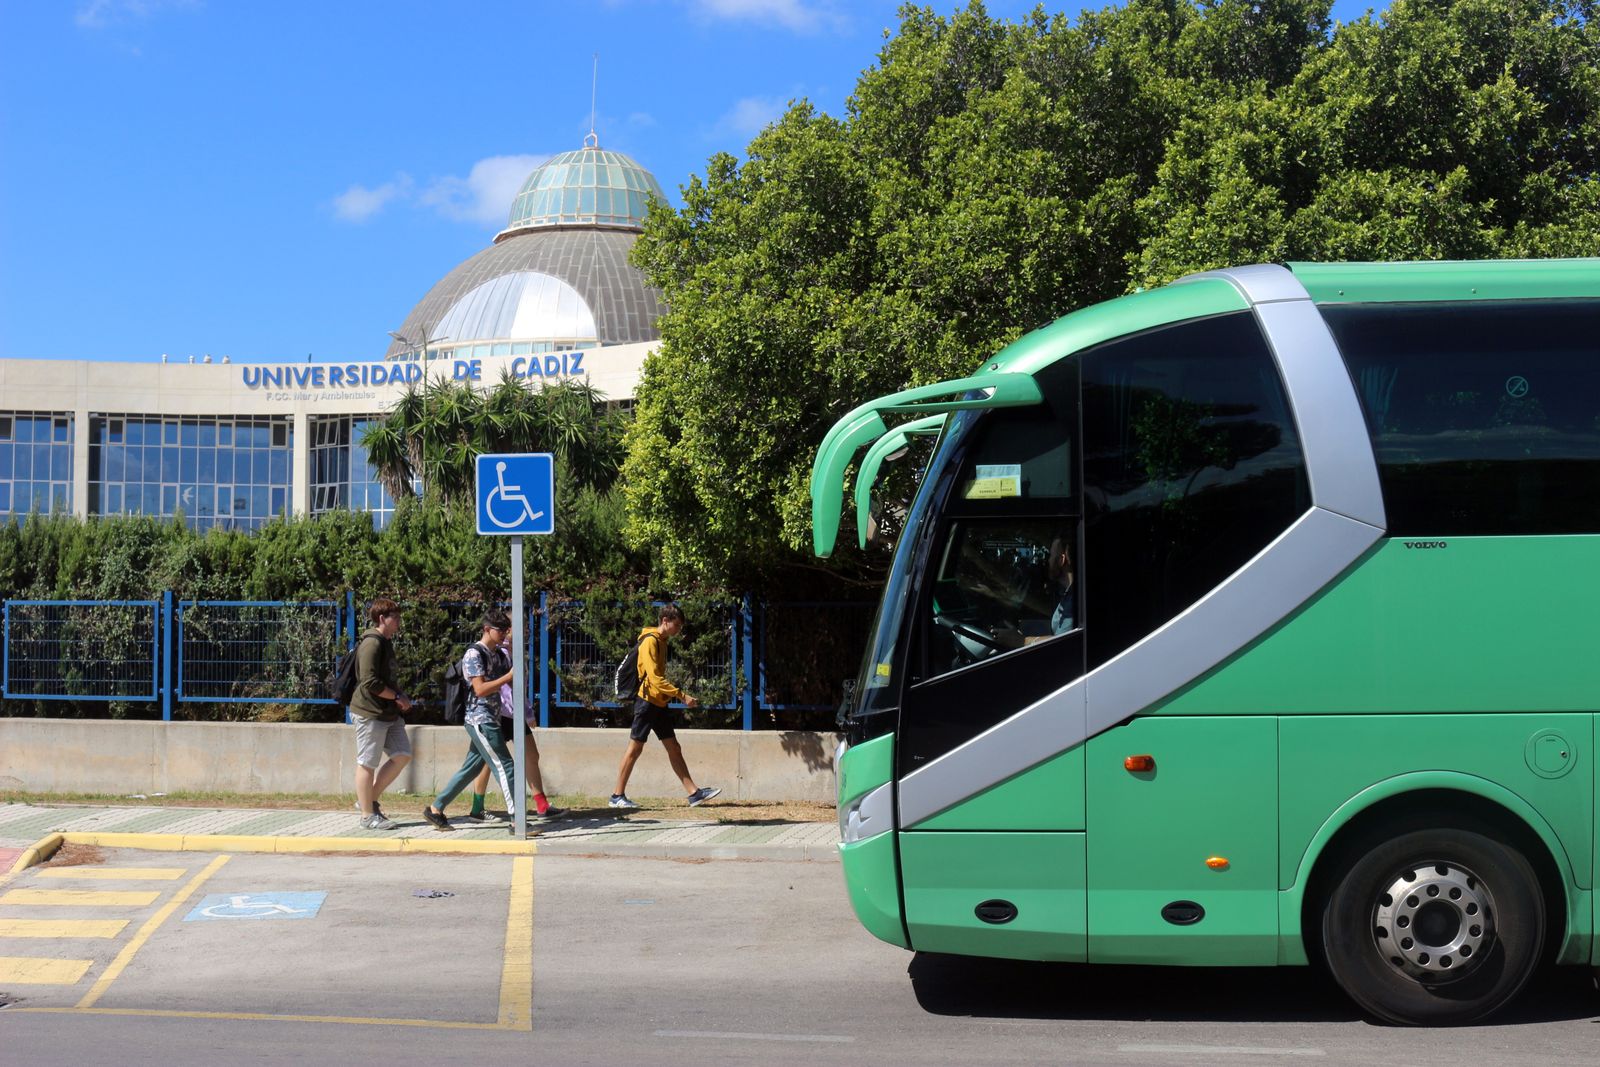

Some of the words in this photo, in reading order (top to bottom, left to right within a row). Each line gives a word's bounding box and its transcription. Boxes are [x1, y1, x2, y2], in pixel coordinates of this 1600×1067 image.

[243, 363, 423, 388] UNIVERSIDAD
[453, 359, 482, 382] DE
[511, 352, 585, 380] CADIZ
[320, 391, 376, 401] Ambientales
[1403, 541, 1448, 549] VOLVO
